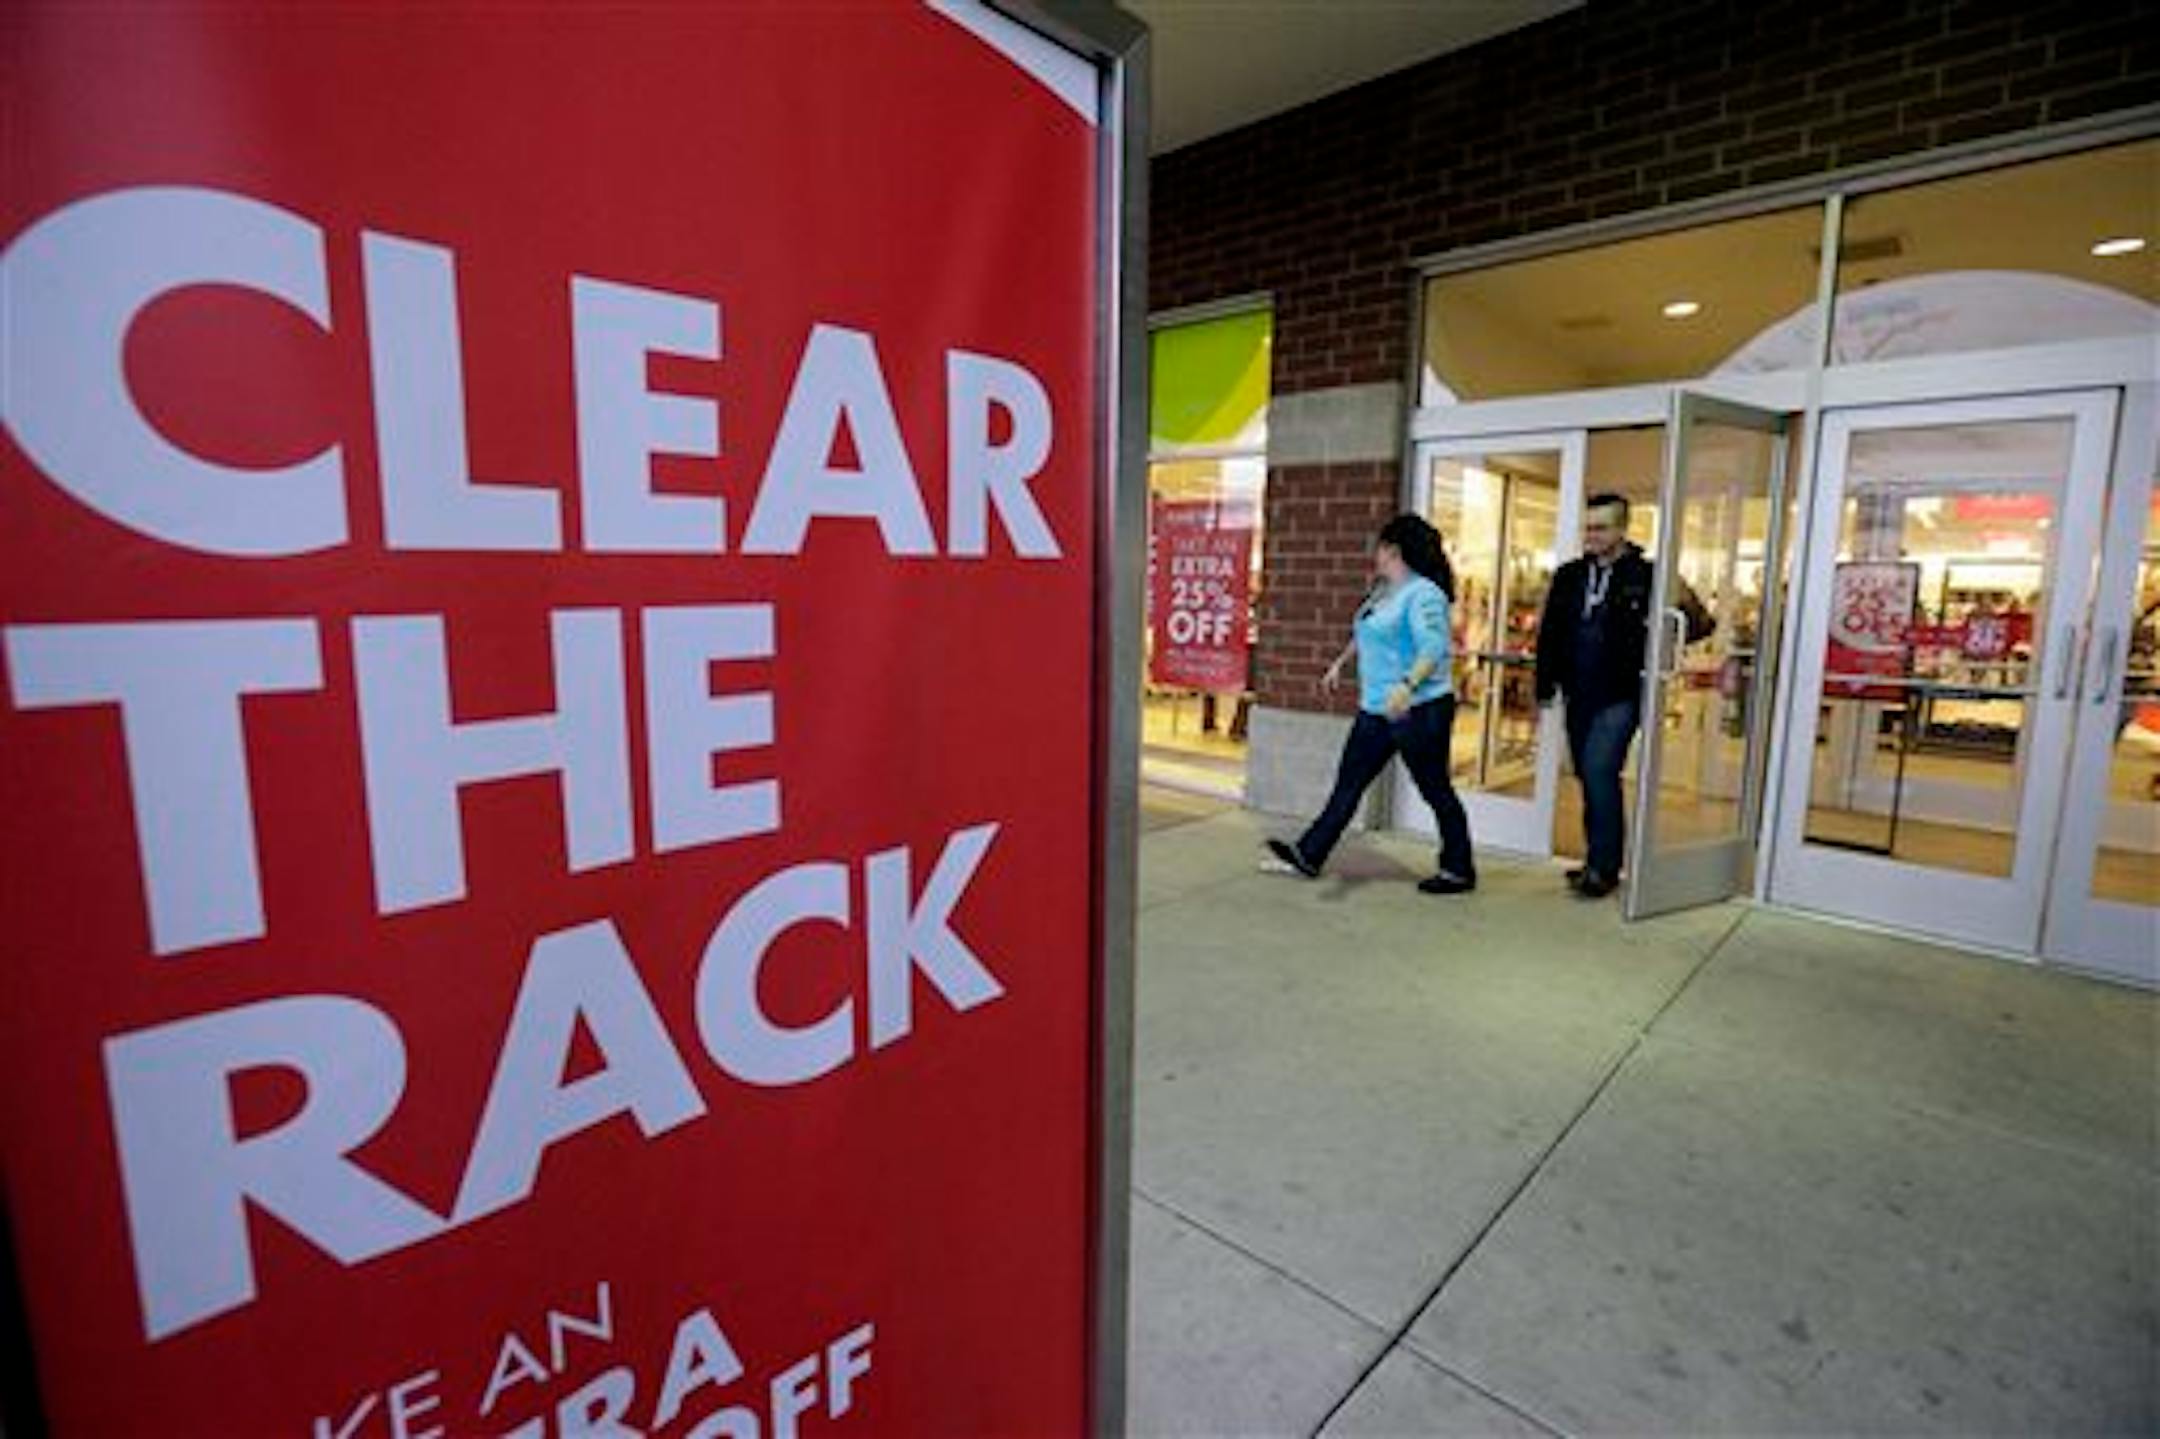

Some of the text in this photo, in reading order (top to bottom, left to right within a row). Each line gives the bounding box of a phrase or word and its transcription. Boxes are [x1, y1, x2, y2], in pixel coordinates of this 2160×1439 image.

[0, 186, 1061, 558] CLEAR
[1167, 609, 1233, 645] OFF
[1171, 578, 1233, 610] 25%
[1172, 555, 1234, 577] EXTRA
[4, 604, 780, 954] THE
[106, 823, 1003, 1338] RACK
[481, 1283, 611, 1413] AN
